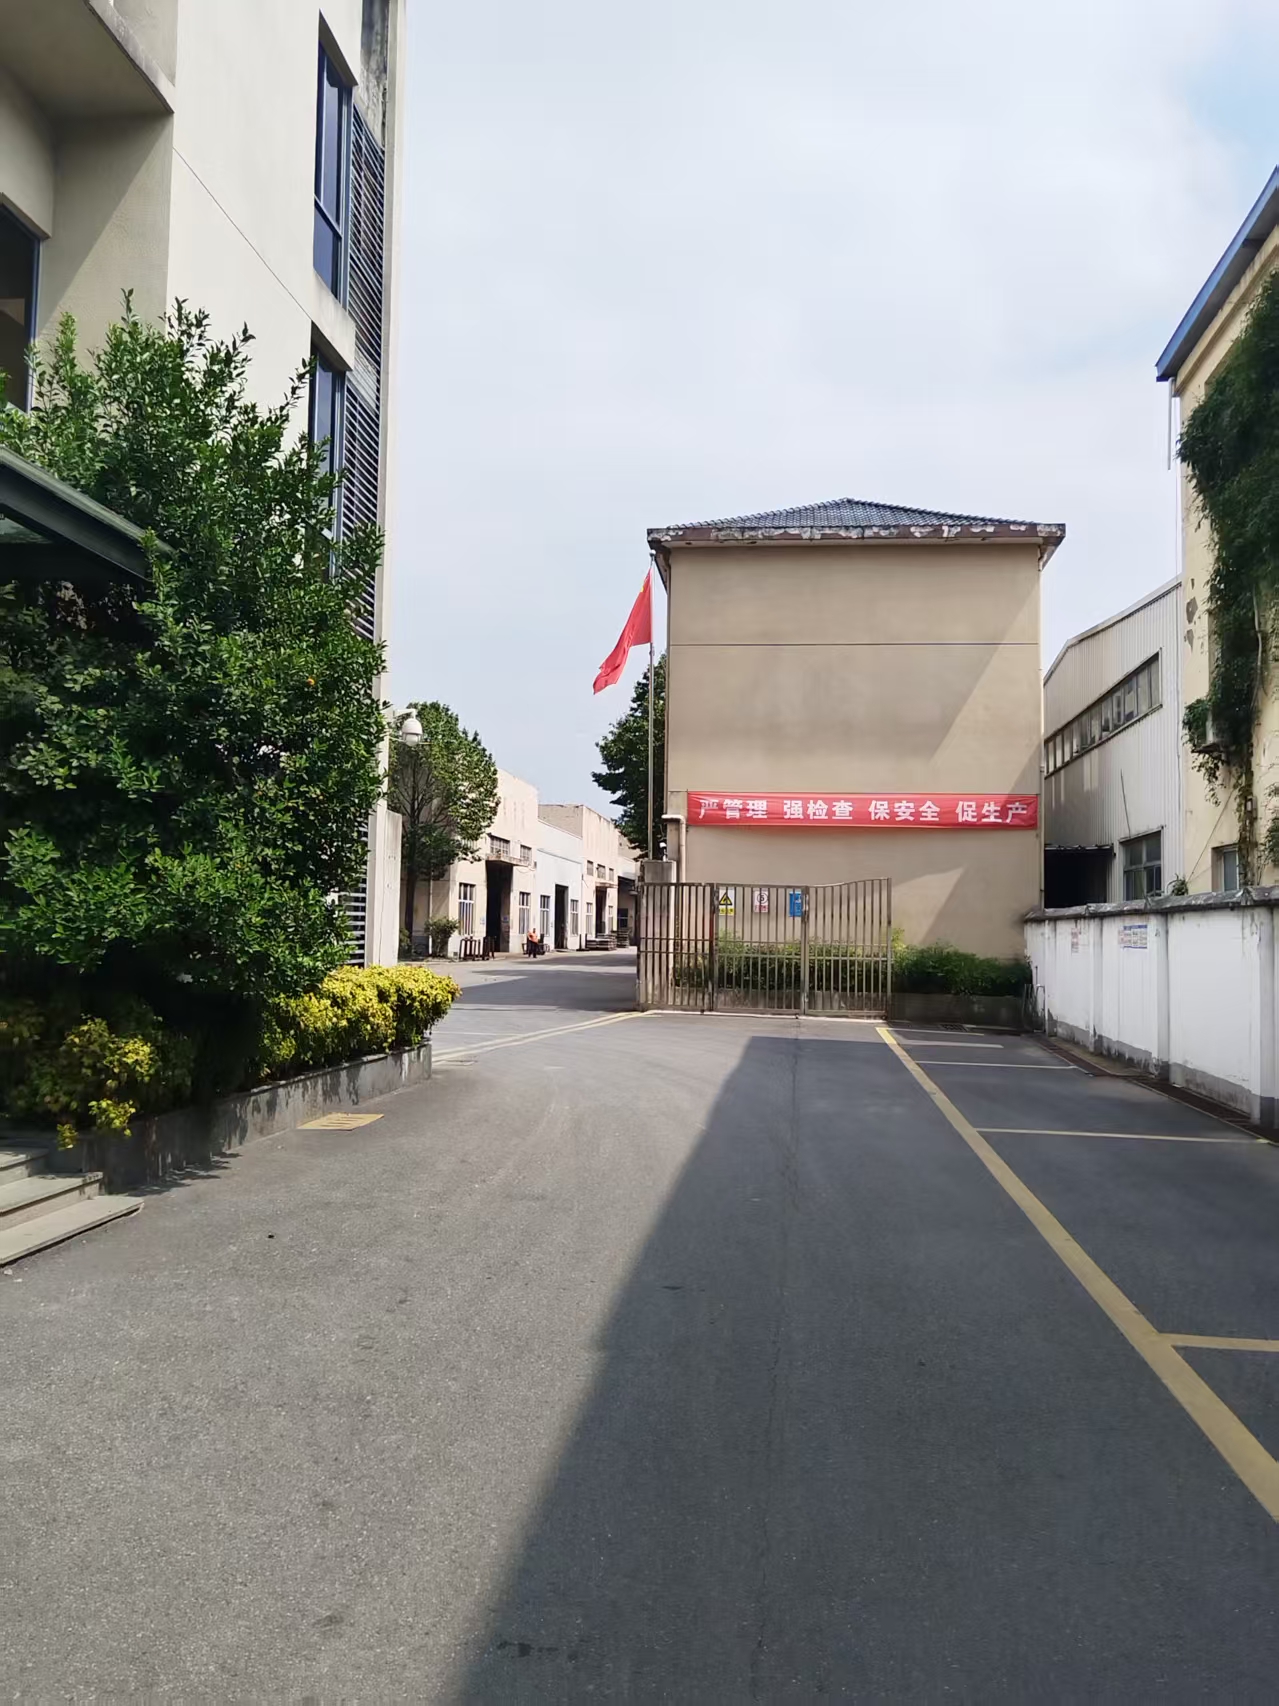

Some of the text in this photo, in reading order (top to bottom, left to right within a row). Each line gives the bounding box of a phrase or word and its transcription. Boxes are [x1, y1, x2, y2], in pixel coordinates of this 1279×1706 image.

[699, 798, 1028, 824] 严管理 强检查 保安全 促生产
